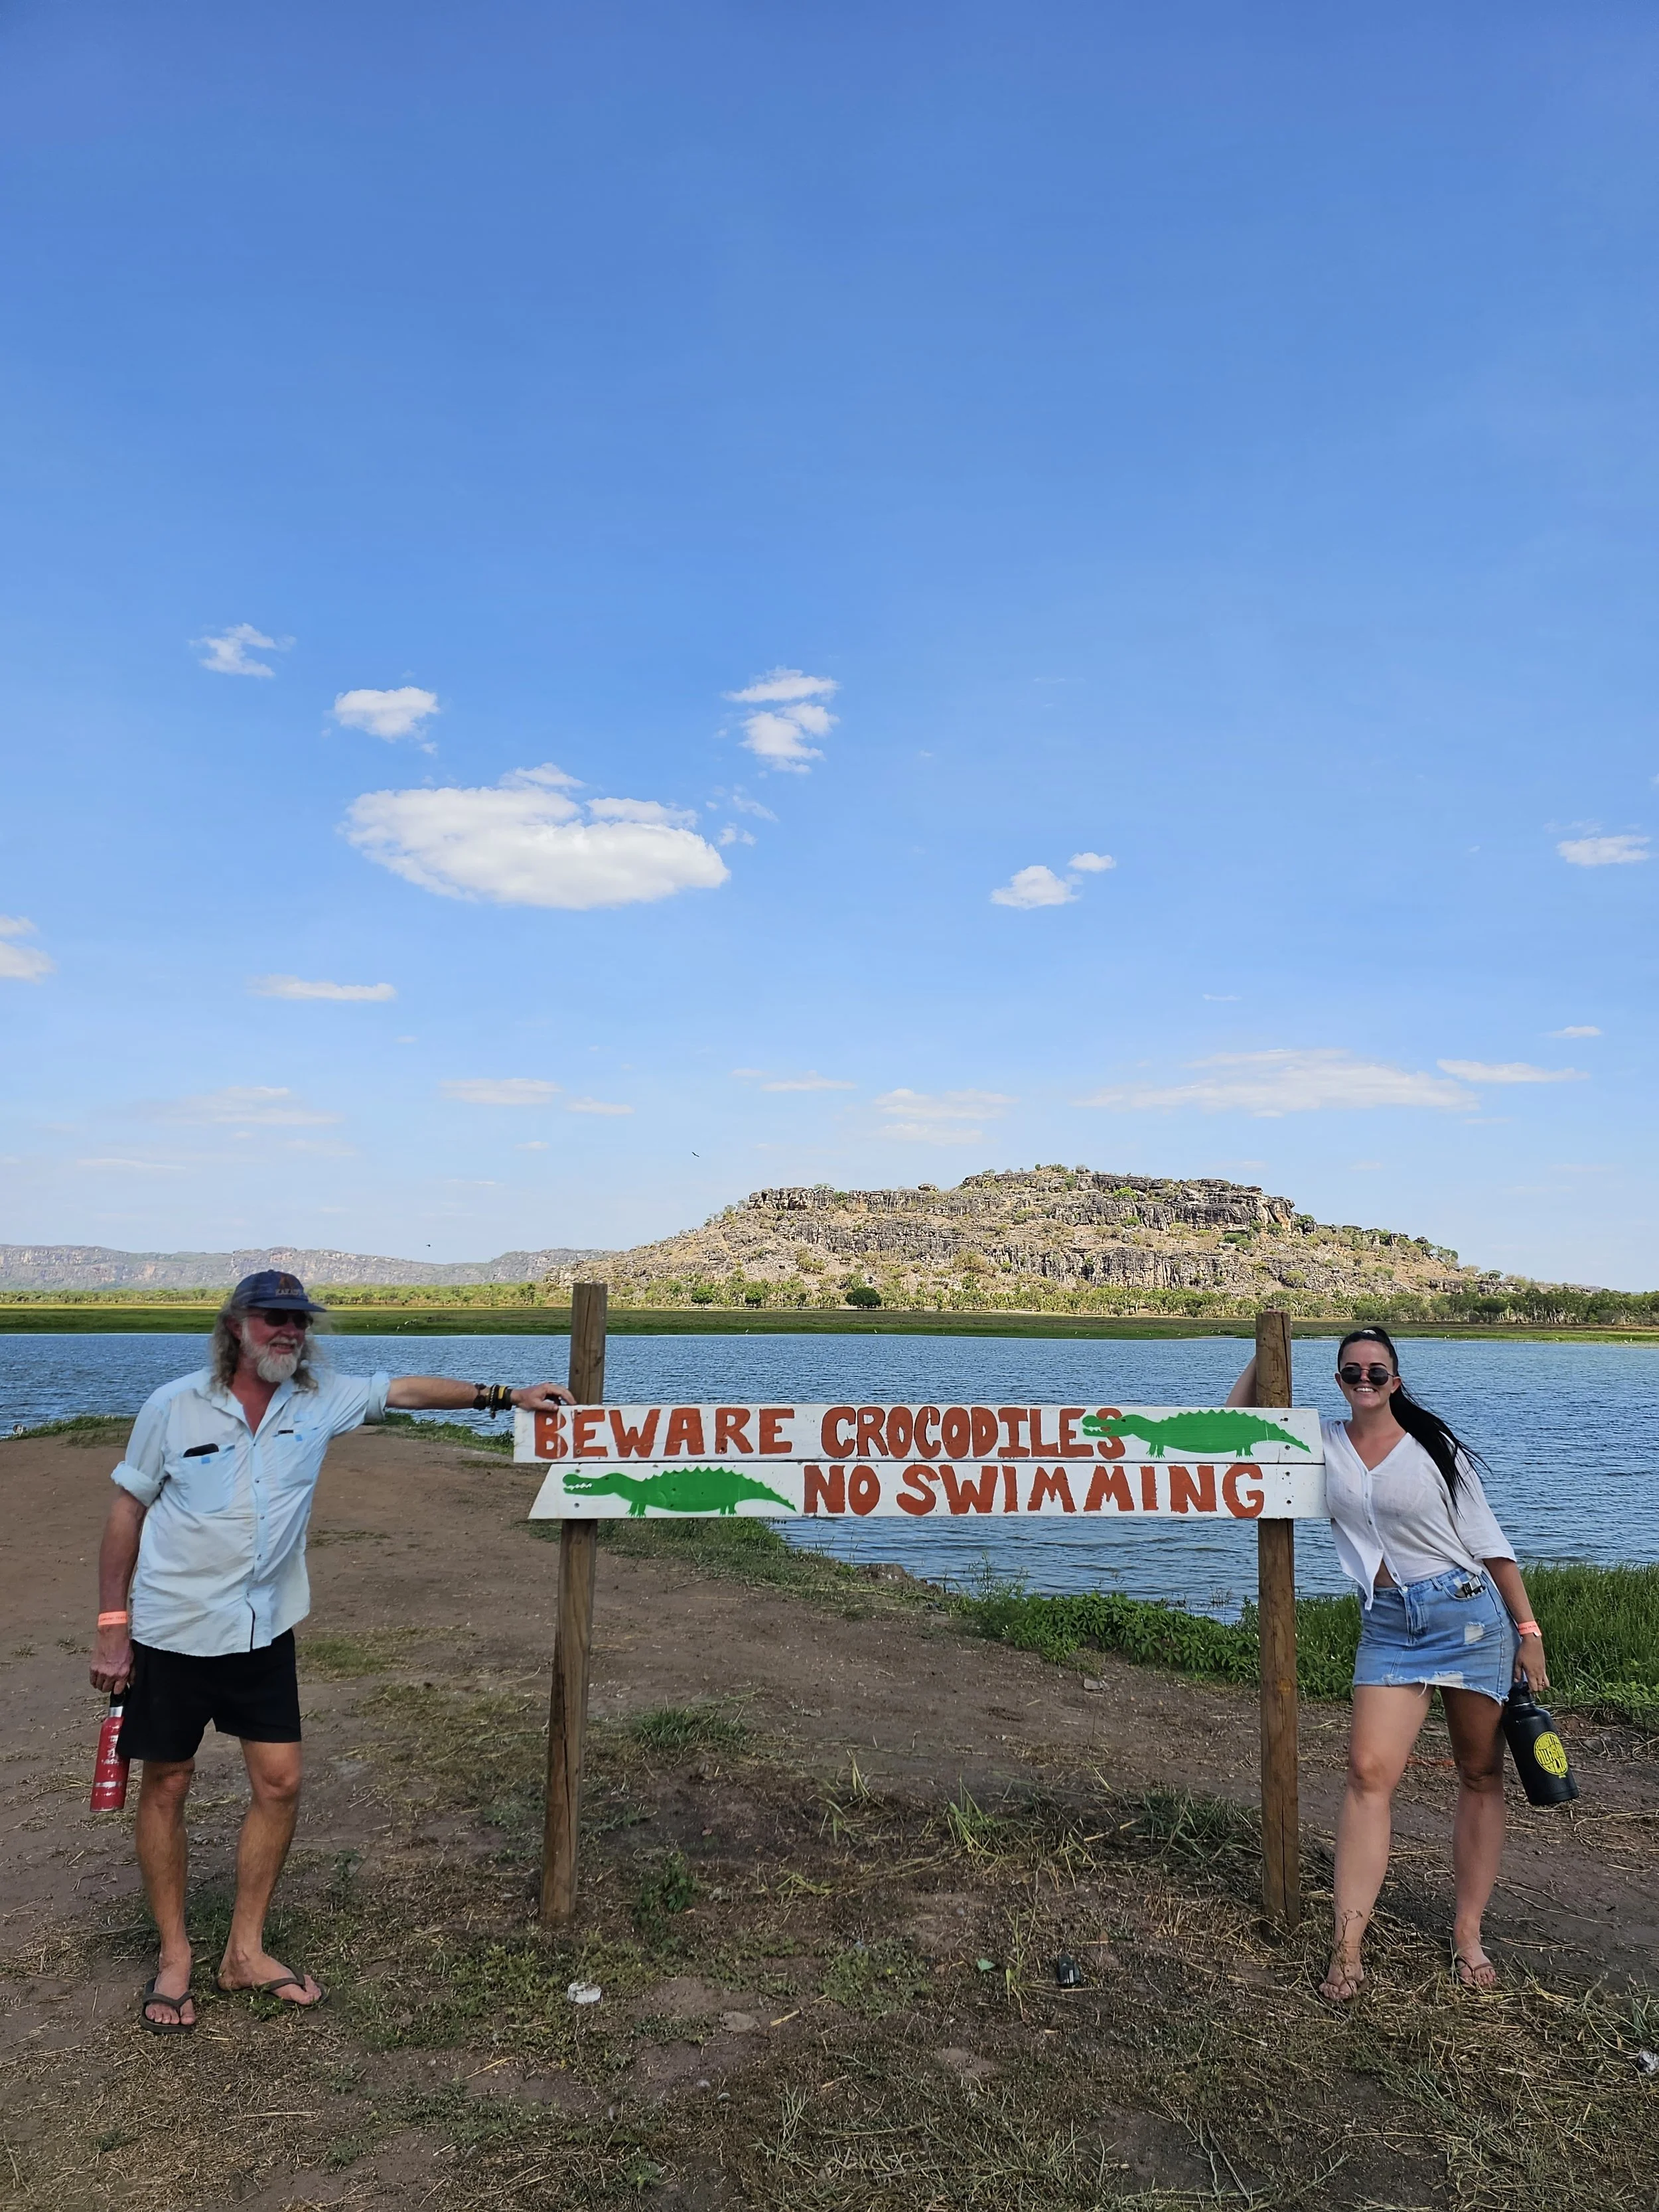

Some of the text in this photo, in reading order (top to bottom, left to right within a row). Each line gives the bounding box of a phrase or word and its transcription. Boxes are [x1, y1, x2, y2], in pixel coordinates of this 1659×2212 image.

[536, 1407, 1125, 1458] BEWARE CROCODILES
[806, 1464, 1263, 1518] NO SWIMMING
